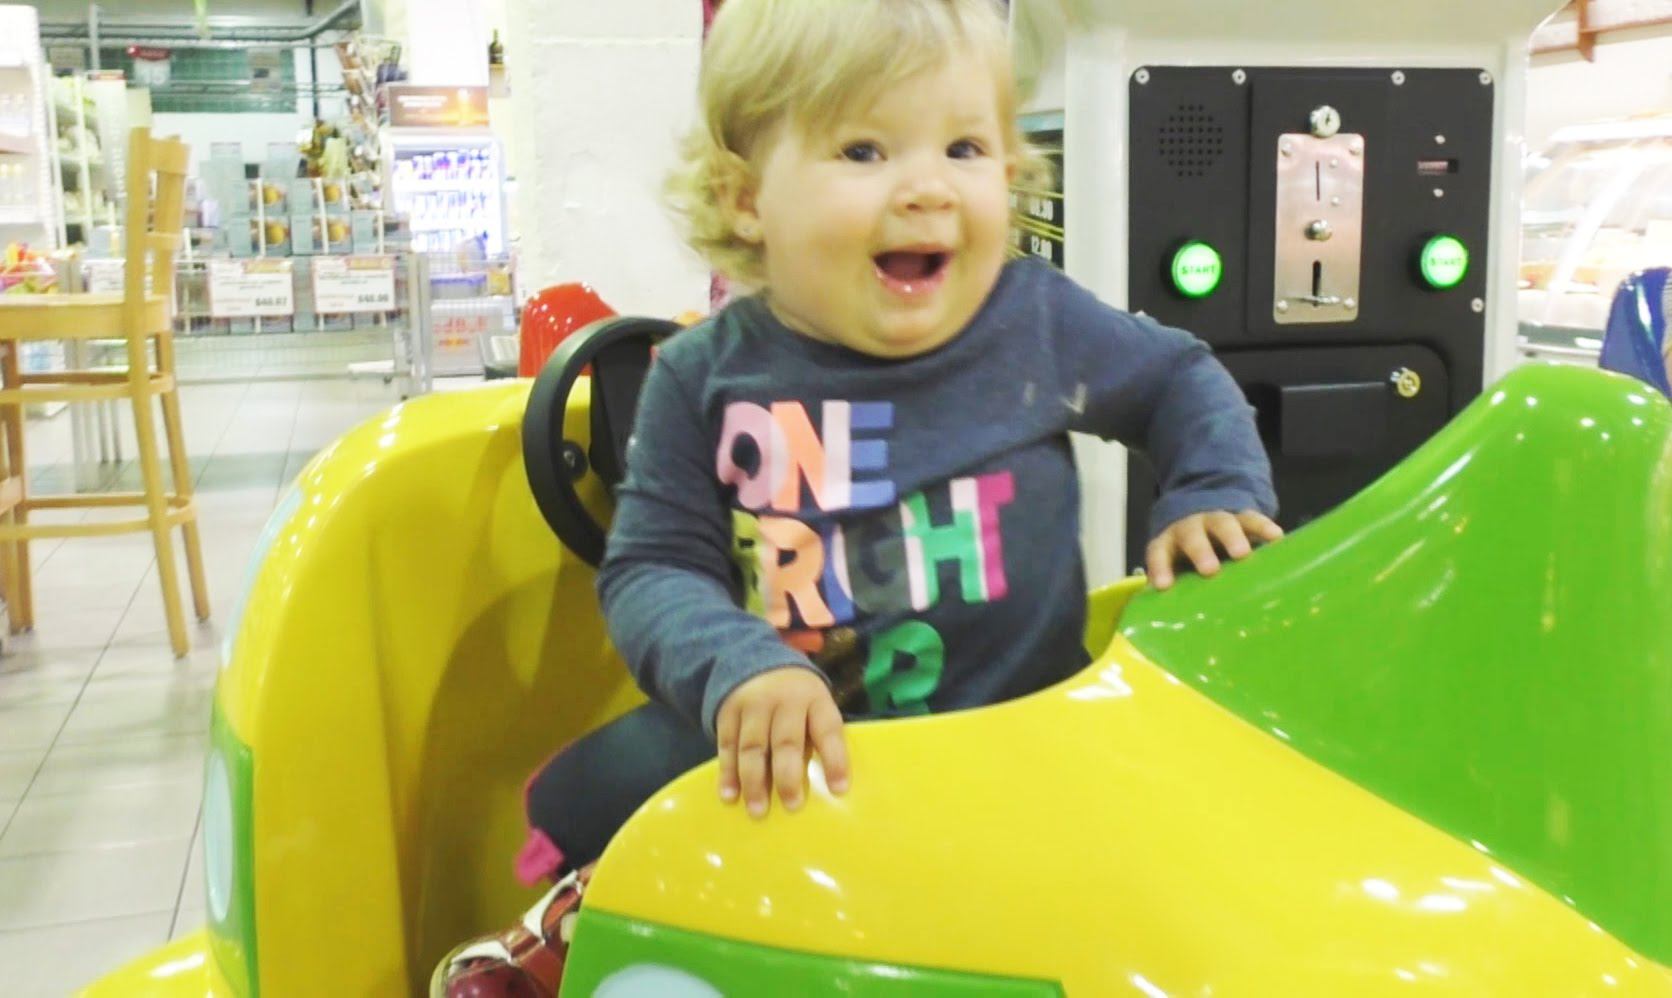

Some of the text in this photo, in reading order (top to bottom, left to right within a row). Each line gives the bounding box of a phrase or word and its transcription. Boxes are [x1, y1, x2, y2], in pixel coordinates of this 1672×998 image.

[1181, 264, 1216, 275] START
[716, 400, 895, 512] ONE
[731, 471, 1015, 629] BRIGHT
